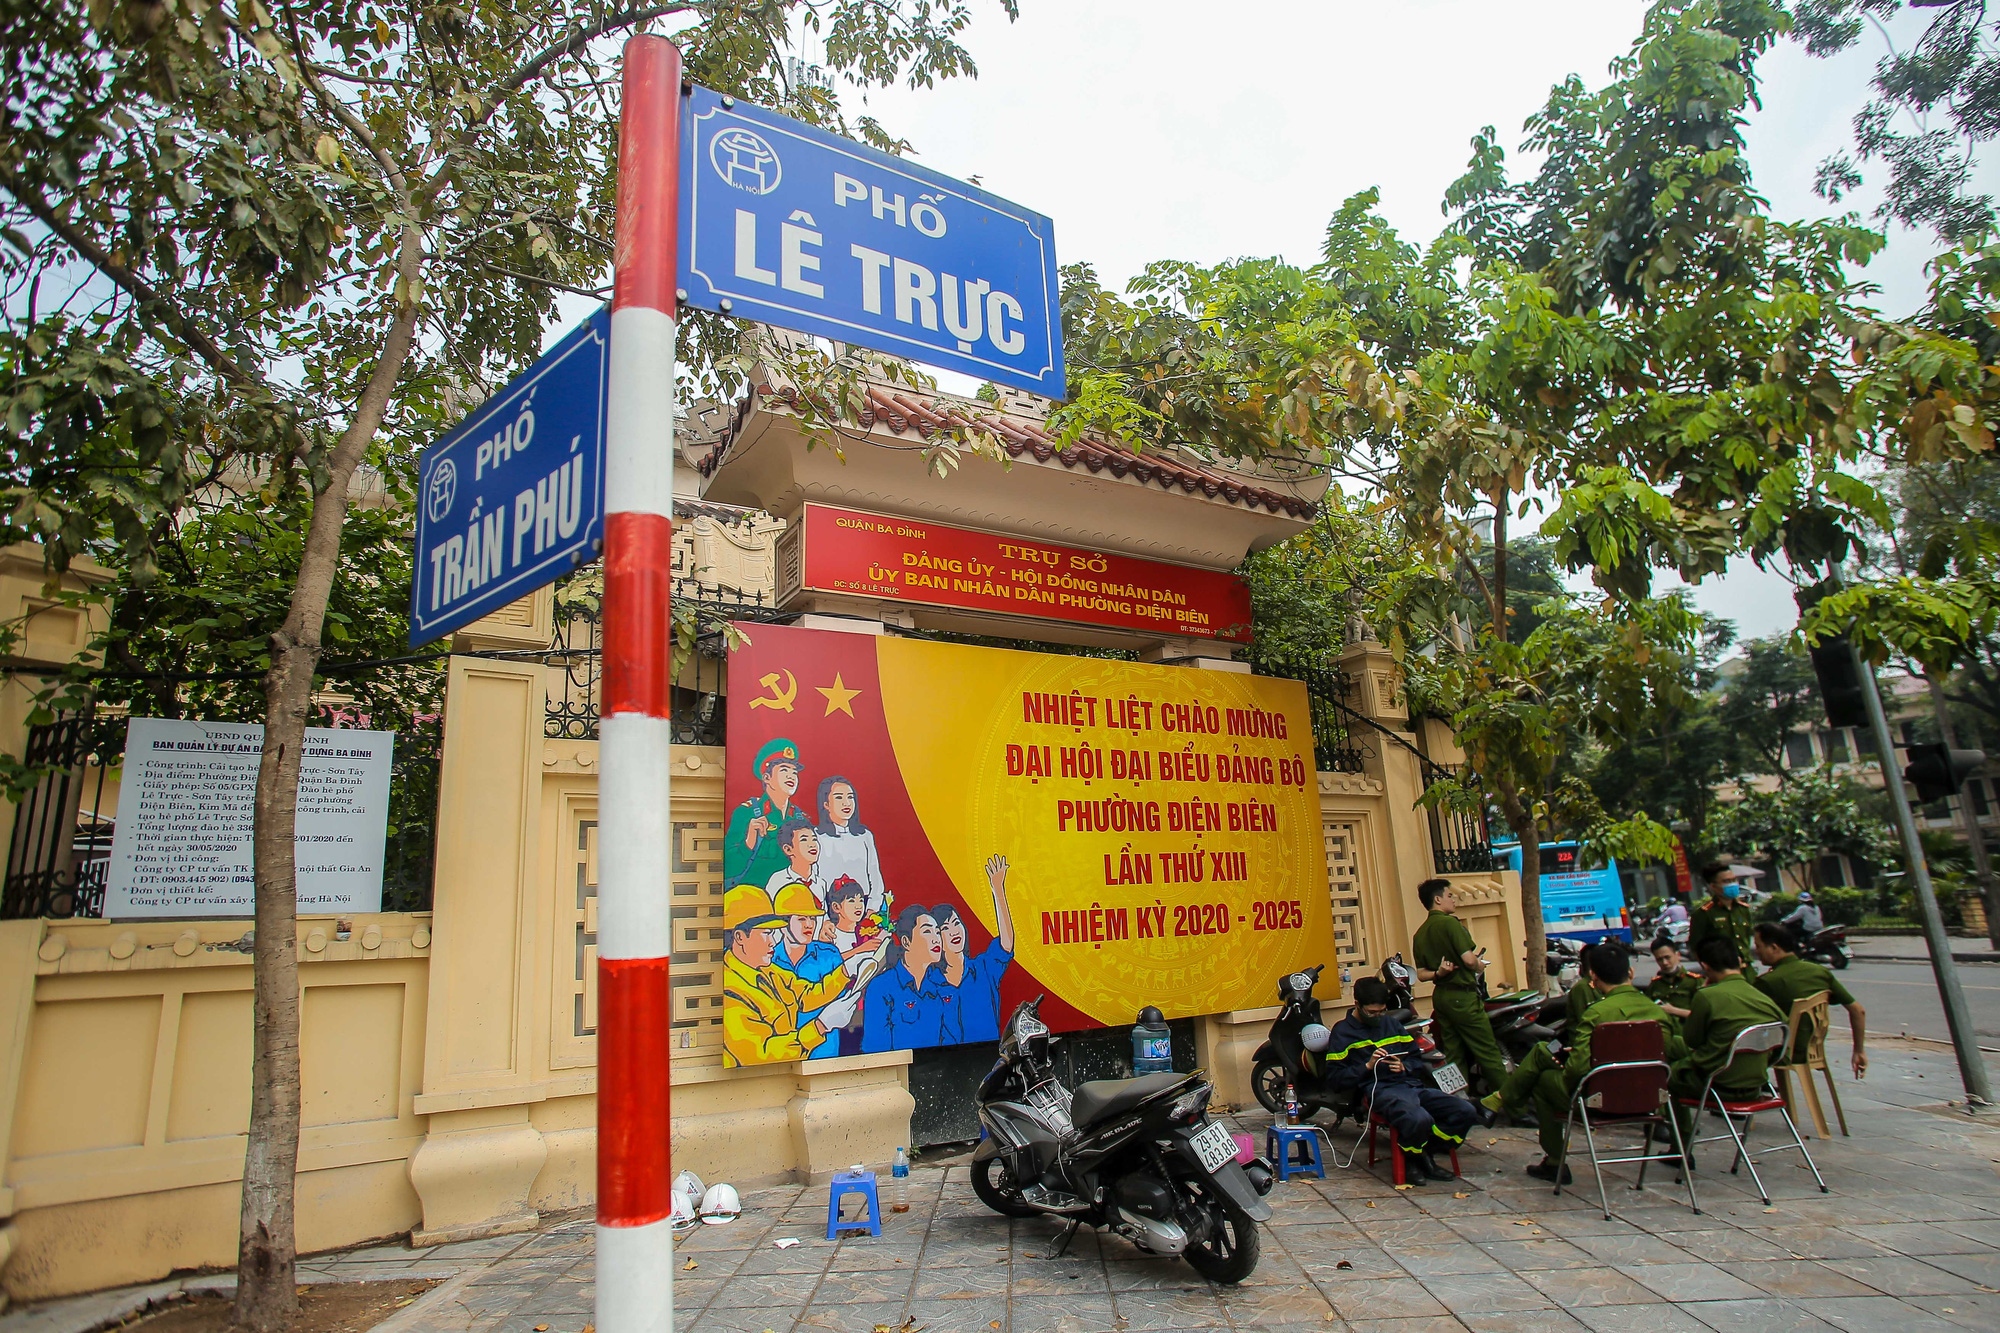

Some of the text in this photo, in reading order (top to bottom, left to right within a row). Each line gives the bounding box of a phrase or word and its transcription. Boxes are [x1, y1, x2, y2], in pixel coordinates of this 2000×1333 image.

[833, 171, 948, 239] PHỐ
[734, 208, 1026, 356] LÊ TRỰC
[475, 386, 538, 482] PHỐ
[431, 434, 583, 612] TRẦN PHÚ
[835, 517, 927, 540] QUẬN BA ĐÌNH
[998, 543, 1108, 573] TRỤ SỞ
[902, 550, 1186, 606] ĐẢNG ỦY HỘI ĐỒNG NHÂN DÂN
[861, 583, 867, 591] 8
[880, 585, 900, 596] TRỰC
[868, 562, 1209, 625] ỦY BAN NHÂN DÂN PHƯỜNG ĐIỆN BIÊN
[1022, 689, 1288, 740] NHIỆT LIỆT CHÀO MỪNG
[206, 732, 240, 741] UBND
[153, 741, 174, 749] BAN
[177, 740, 205, 751] QUẢN
[309, 748, 334, 757] DỰNG
[336, 749, 348, 757] BA
[350, 749, 372, 758] ĐÌNH
[146, 760, 174, 770] Công
[176, 761, 206, 770] trình:
[229, 763, 245, 772] tạo
[328, 767, 345, 775] Sơn
[348, 768, 365, 777] Tây
[1006, 741, 1306, 792] ĐẠI HỘI ĐẠI BIỂU ĐẢNG BỘ
[145, 770, 163, 780] Địa
[198, 772, 237, 782] Phường
[240, 774, 257, 783] Điệ
[298, 776, 323, 785] Quận
[340, 777, 362, 785] Đình
[143, 781, 169, 790] Giấy
[171, 782, 200, 791] phép:
[202, 782, 217, 790] Số
[322, 786, 334, 794] hè
[336, 786, 354, 795] phố
[141, 791, 155, 799] Lê
[158, 792, 183, 801] Trực
[215, 793, 234, 802] Tây
[317, 796, 353, 805] phường
[140, 802, 165, 811] Điện
[168, 802, 195, 811] Biên,
[198, 803, 219, 811] Kim
[297, 806, 320, 814] công
[1057, 793, 1277, 838] PHƯỜNG ĐIỆN BIÊN
[138, 812, 237, 823] tạo hè phố Lê Trực
[137, 821, 234, 832] Tổng lượng đào hè
[136, 833, 354, 844] Thời gian thực hiện: đến
[137, 842, 237, 853] hết ngày 30/05/2020
[135, 854, 219, 863] Đơn vị thi công:
[1103, 842, 1248, 886] LẦN THỨ XIII
[1557, 852, 1573, 862] 22A
[134, 864, 371, 874] Công ty CP tư vấn TK nội thất Gia An
[162, 876, 206, 884] 0903.445
[208, 875, 230, 884] 902)
[130, 887, 153, 895] Đơn
[156, 887, 166, 896] vị
[169, 885, 195, 894] thiết
[130, 895, 351, 906] Công ty CP tư vấn xây Hà Nội
[1041, 899, 1304, 950] NHIỆM KỲ 2020 2025
[1196, 1125, 1225, 1153] 29-B1
[1203, 1138, 1237, 1170] 483.88
